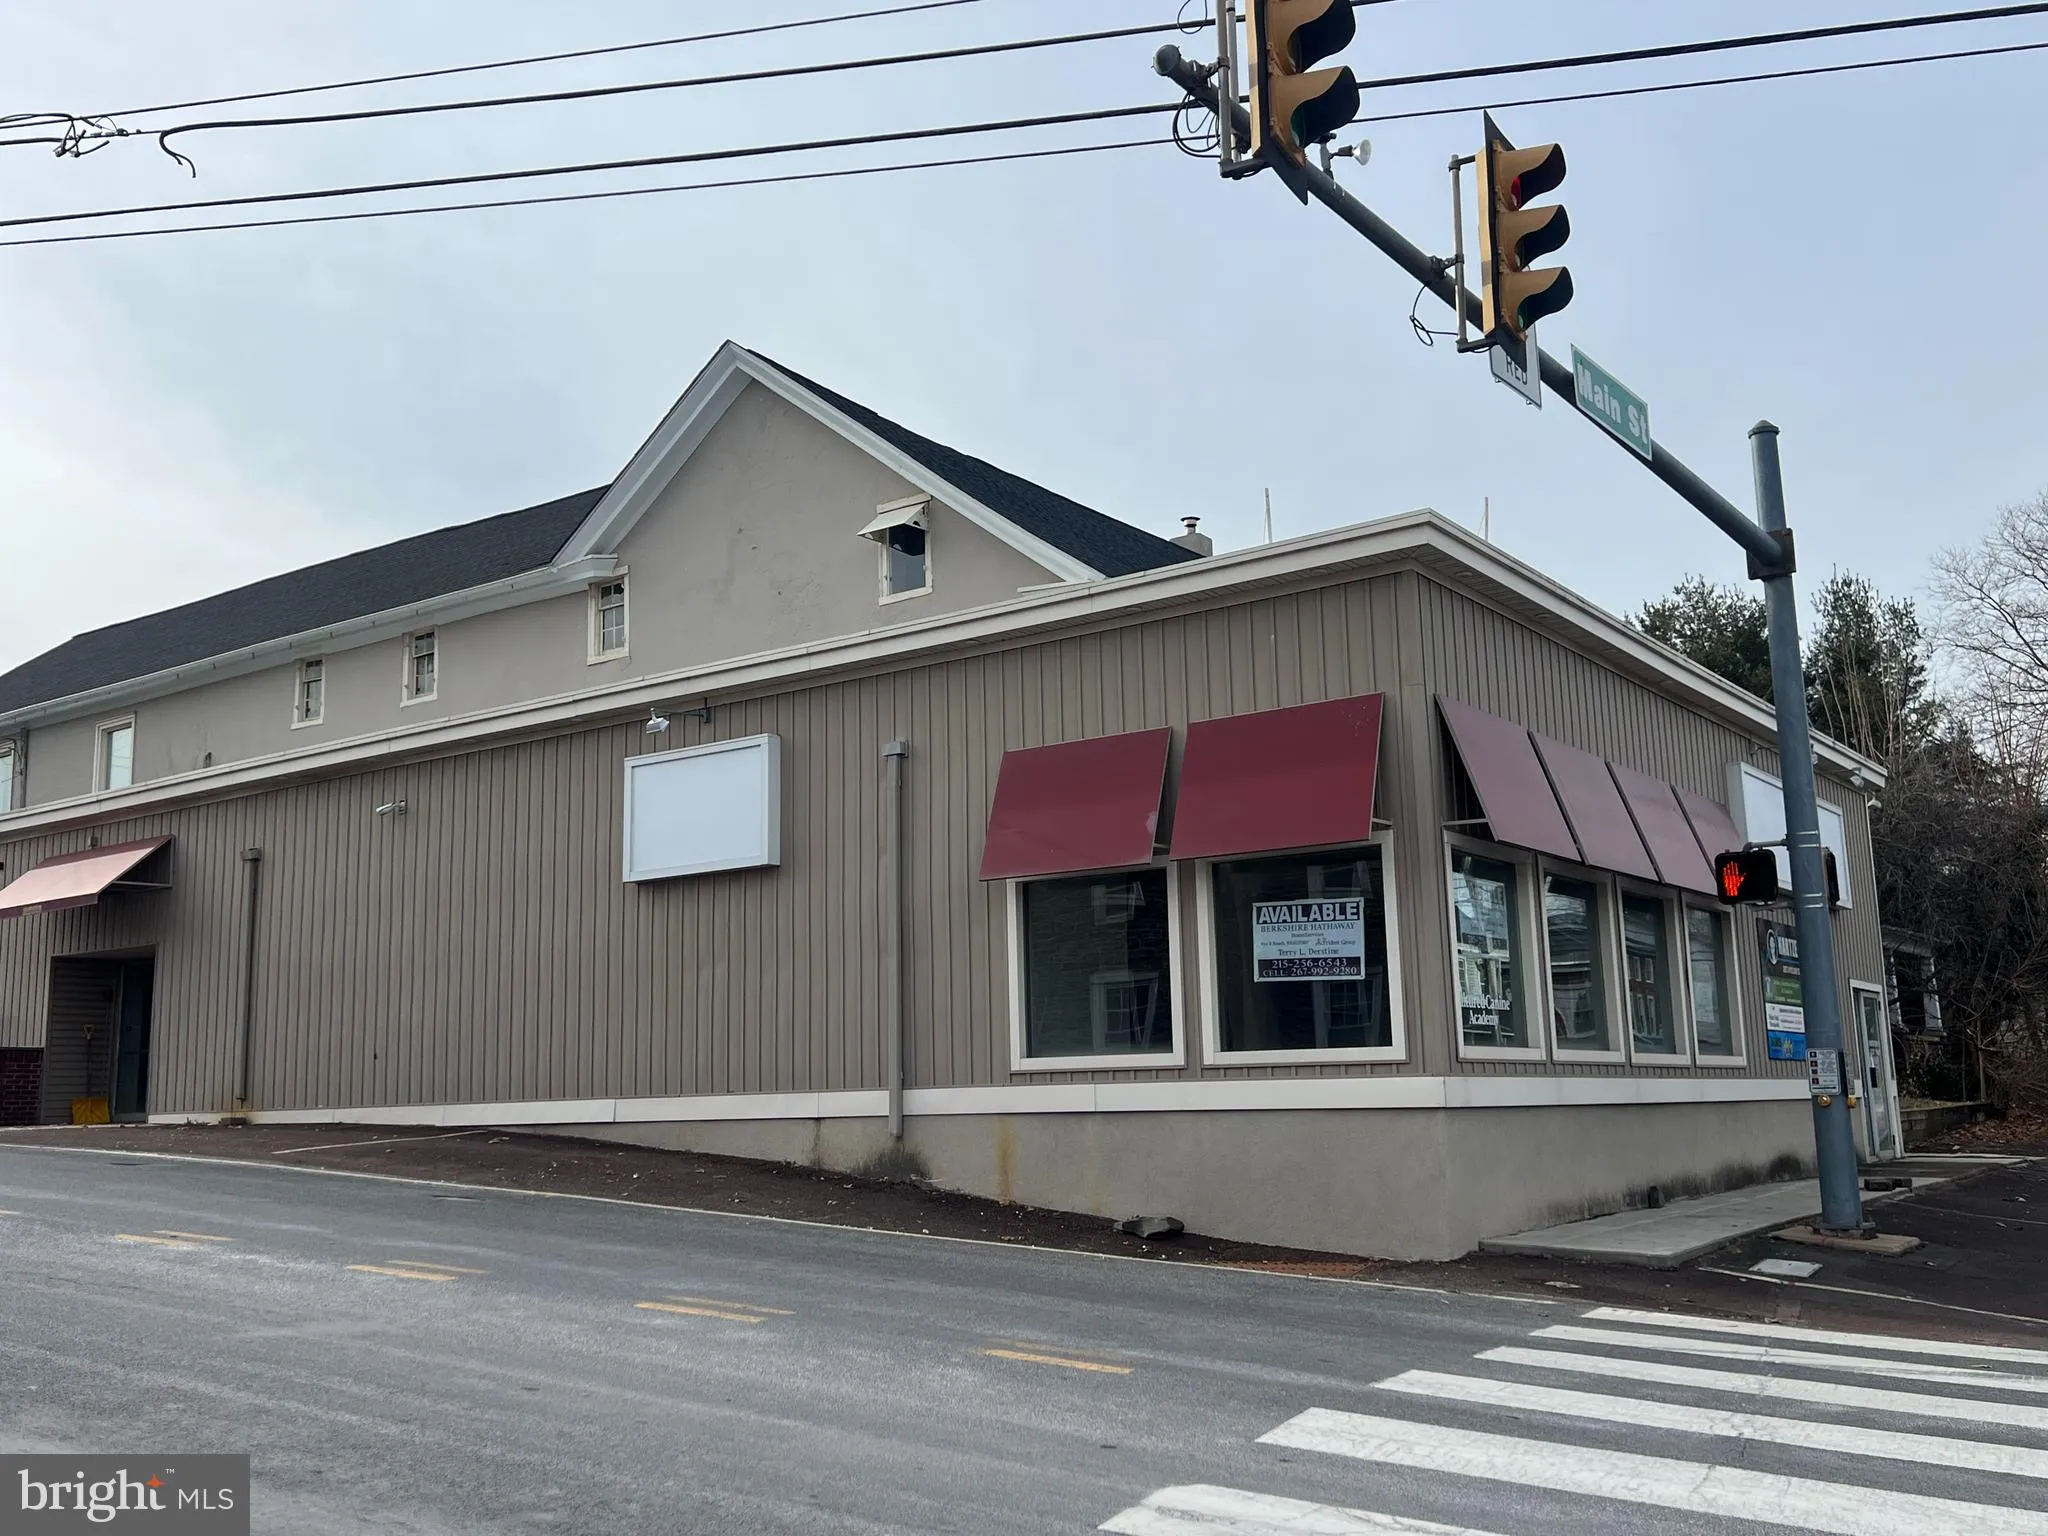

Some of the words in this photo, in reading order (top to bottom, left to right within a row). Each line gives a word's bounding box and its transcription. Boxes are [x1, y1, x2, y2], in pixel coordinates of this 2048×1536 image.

[1577, 361, 1622, 424] Main
[1627, 405, 1648, 444] St
[1258, 902, 1358, 924] AVAILABLE
[1260, 924, 1309, 933] BERKSHIRE
[1311, 922, 1355, 931] HATHAWAY
[1271, 958, 1347, 969] 215-256-6543
[1262, 969, 1288, 977] CELL:
[1290, 966, 1358, 976] 267-992-9280
